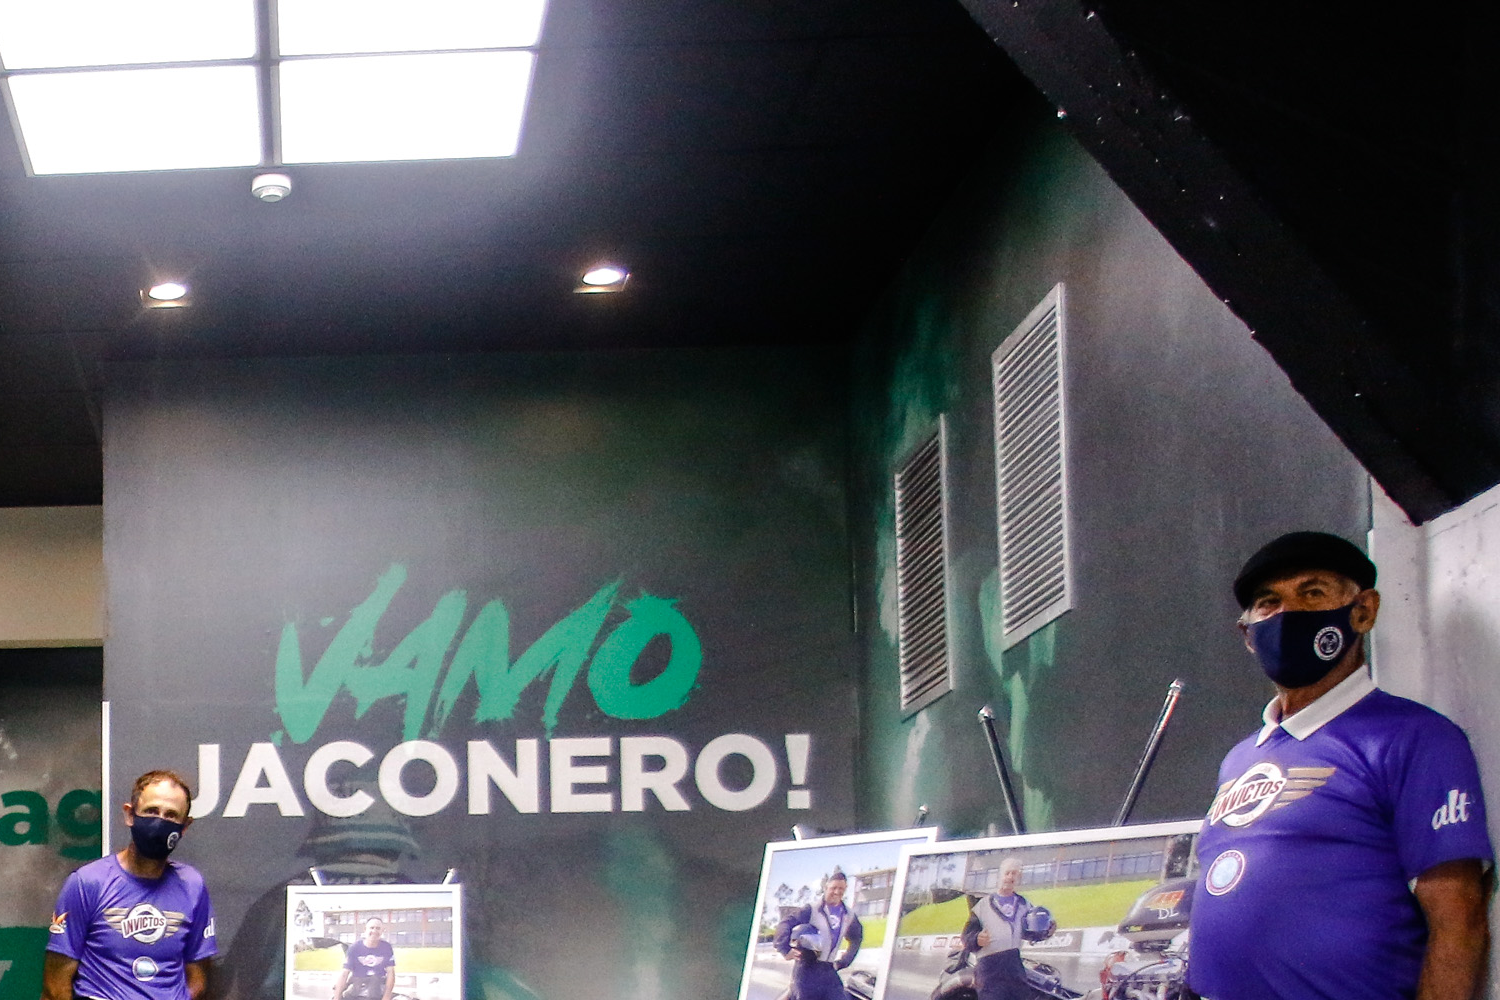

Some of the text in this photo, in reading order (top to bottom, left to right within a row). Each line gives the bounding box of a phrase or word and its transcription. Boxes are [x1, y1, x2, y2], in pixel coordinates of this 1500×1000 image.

[275, 562, 702, 745] VAMO
[191, 733, 812, 819] JACONERO!
[1213, 779, 1284, 819] INVICTOS
[1431, 789, 1471, 830] alt
[122, 915, 165, 935] INVICTOS
